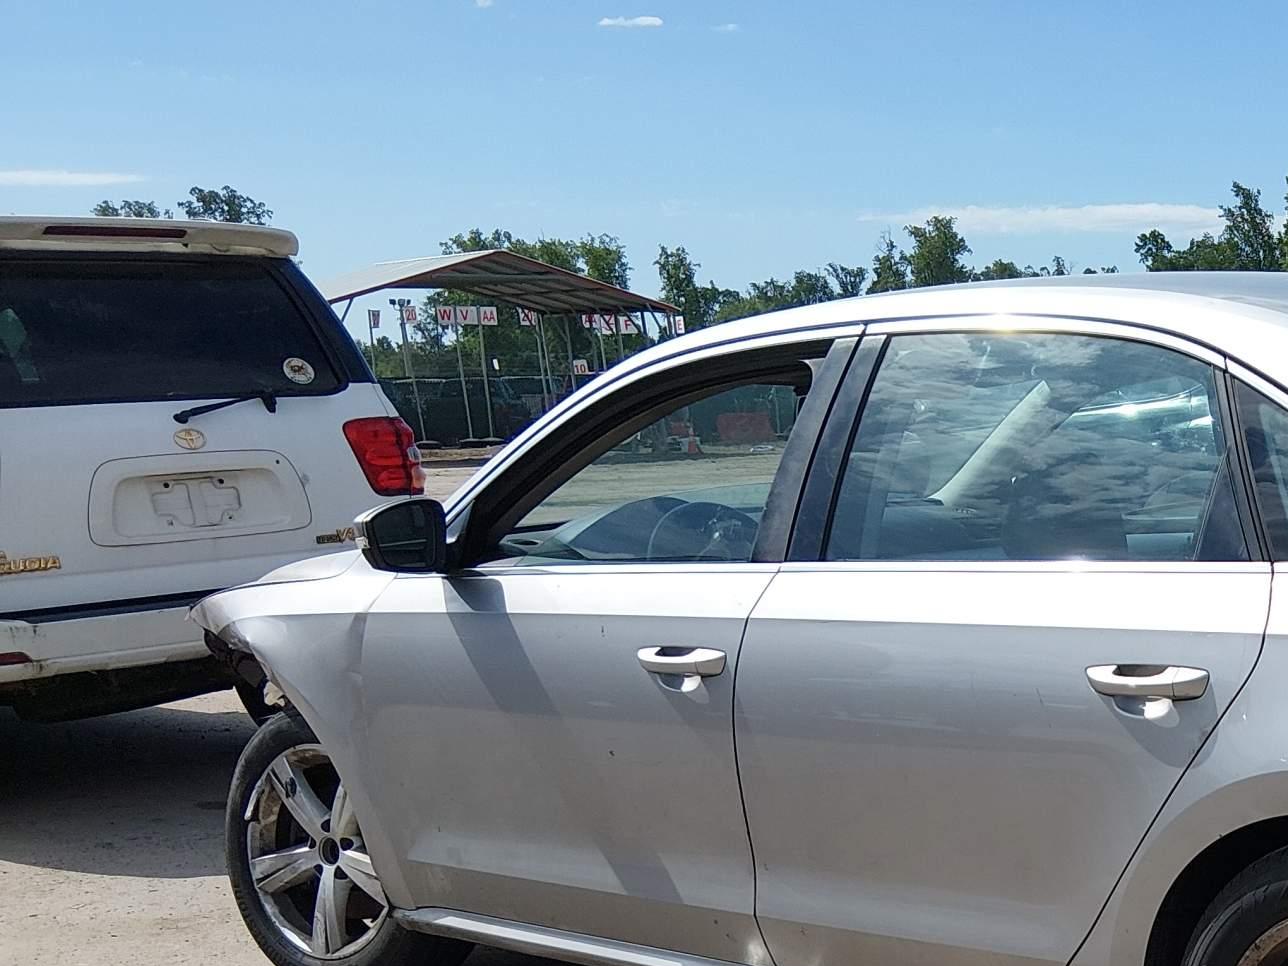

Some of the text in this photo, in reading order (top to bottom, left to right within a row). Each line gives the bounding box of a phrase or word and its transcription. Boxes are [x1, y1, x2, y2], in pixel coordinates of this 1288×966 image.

[404, 308, 417, 321] 20
[439, 309, 452, 321] W
[460, 309, 469, 321] V
[482, 310, 496, 322] AA
[624, 319, 631, 331] F
[575, 363, 586, 374] 10
